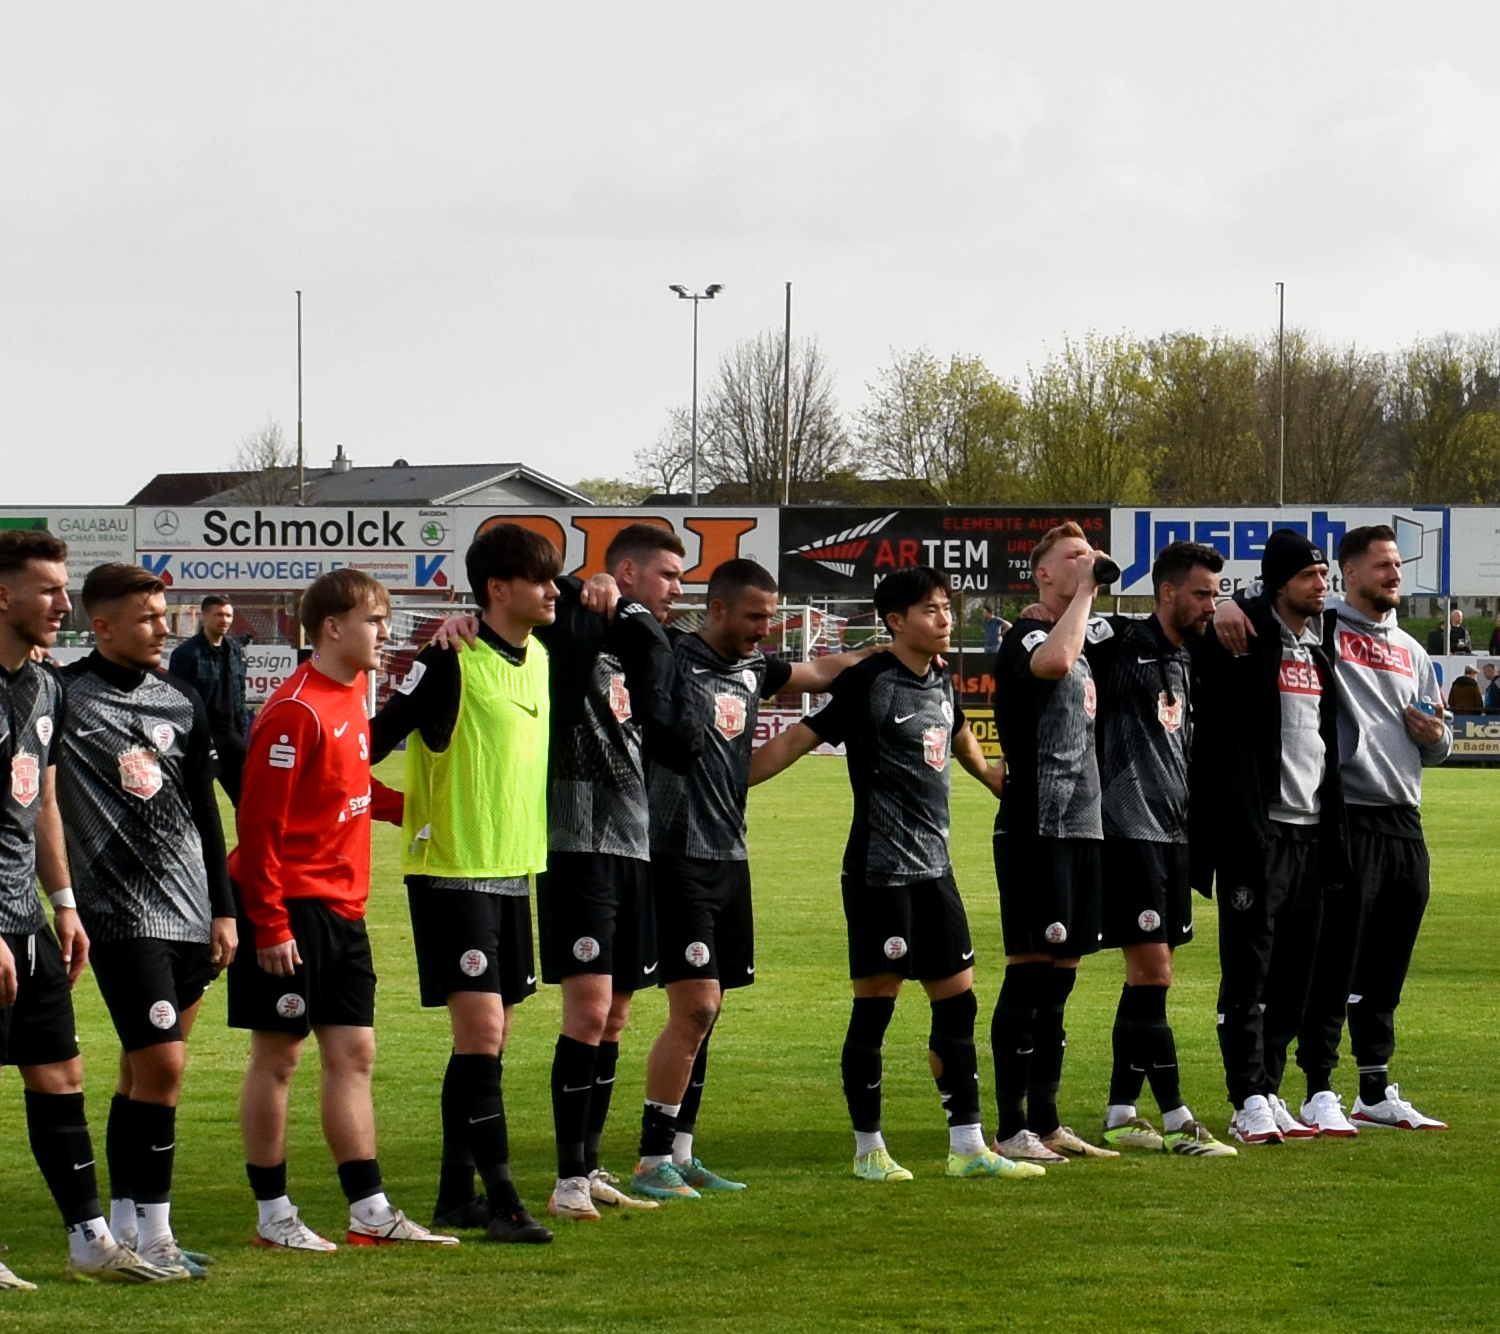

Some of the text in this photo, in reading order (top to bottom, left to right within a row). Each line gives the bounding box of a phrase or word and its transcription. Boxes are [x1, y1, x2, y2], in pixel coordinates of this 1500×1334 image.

[58, 518, 129, 532] GALABAU
[202, 510, 406, 547] Schmolck
[943, 517, 1023, 530] ELEMENTE
[1028, 517, 1058, 530] AUS
[98, 534, 129, 542] BRAND
[873, 539, 989, 569] ARTEM
[246, 651, 292, 673] esign
[1279, 665, 1324, 691] ASSEL
[1463, 741, 1500, 751] Baden
